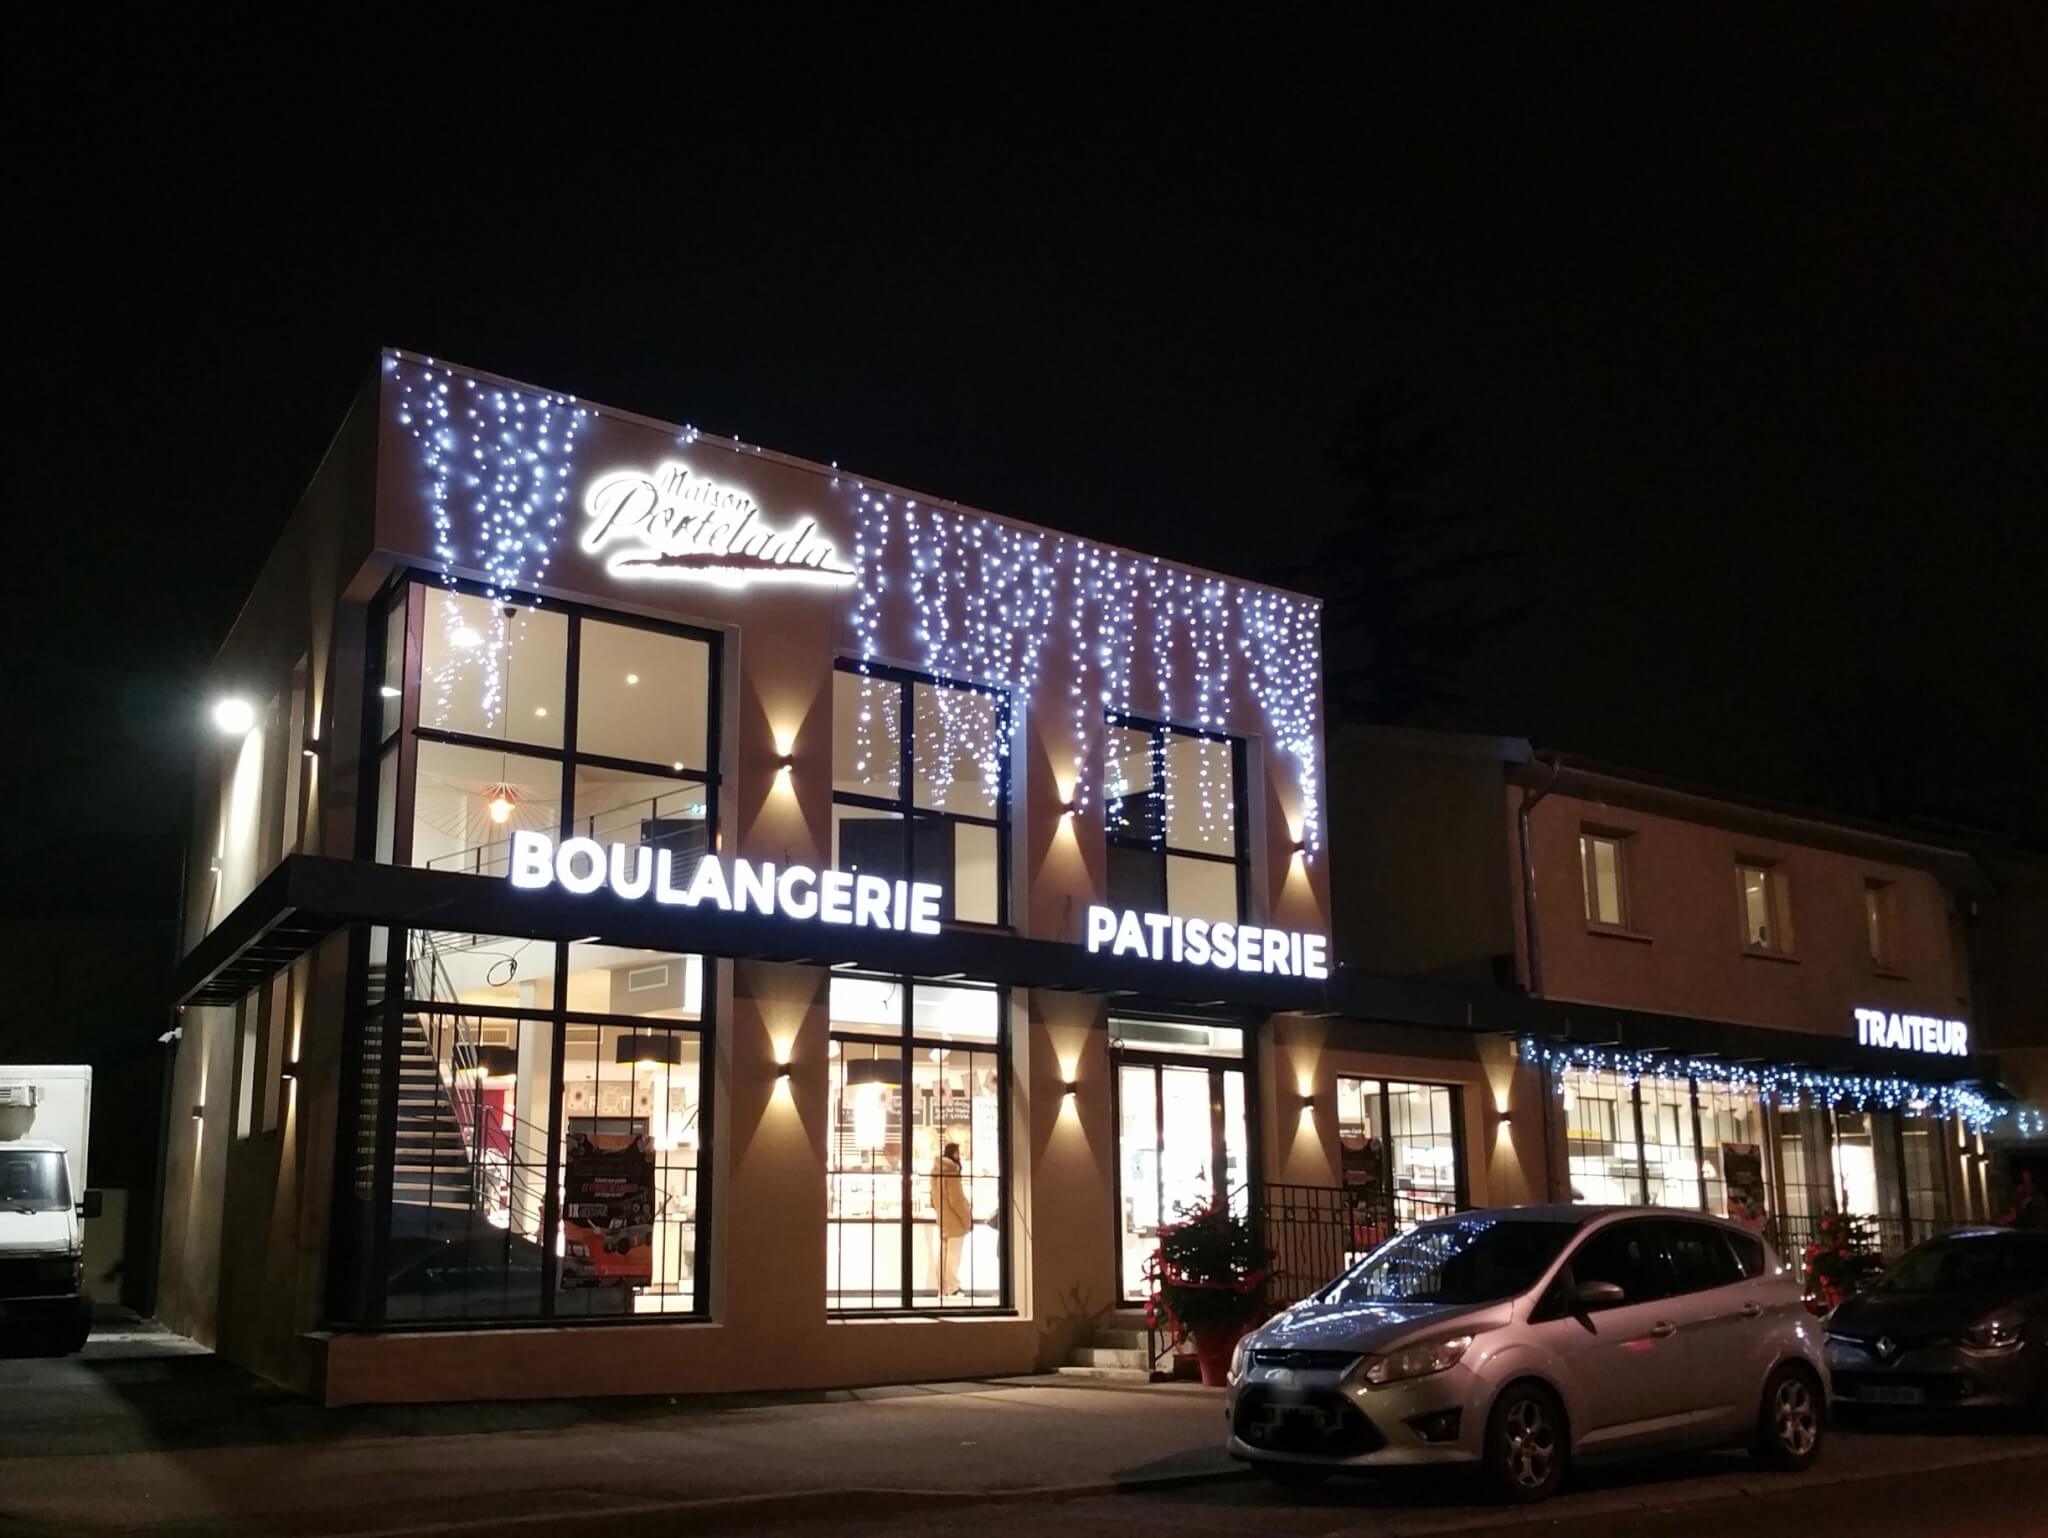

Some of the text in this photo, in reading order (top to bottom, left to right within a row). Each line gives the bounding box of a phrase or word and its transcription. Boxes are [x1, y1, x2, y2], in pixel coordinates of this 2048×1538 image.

[588, 475, 834, 569] Portelada
[658, 465, 752, 513] Maison
[510, 829, 943, 936] BOULANGERIE
[1087, 905, 1329, 980] PATISSERIE
[1854, 1008, 1969, 1057] TRAITEUR
